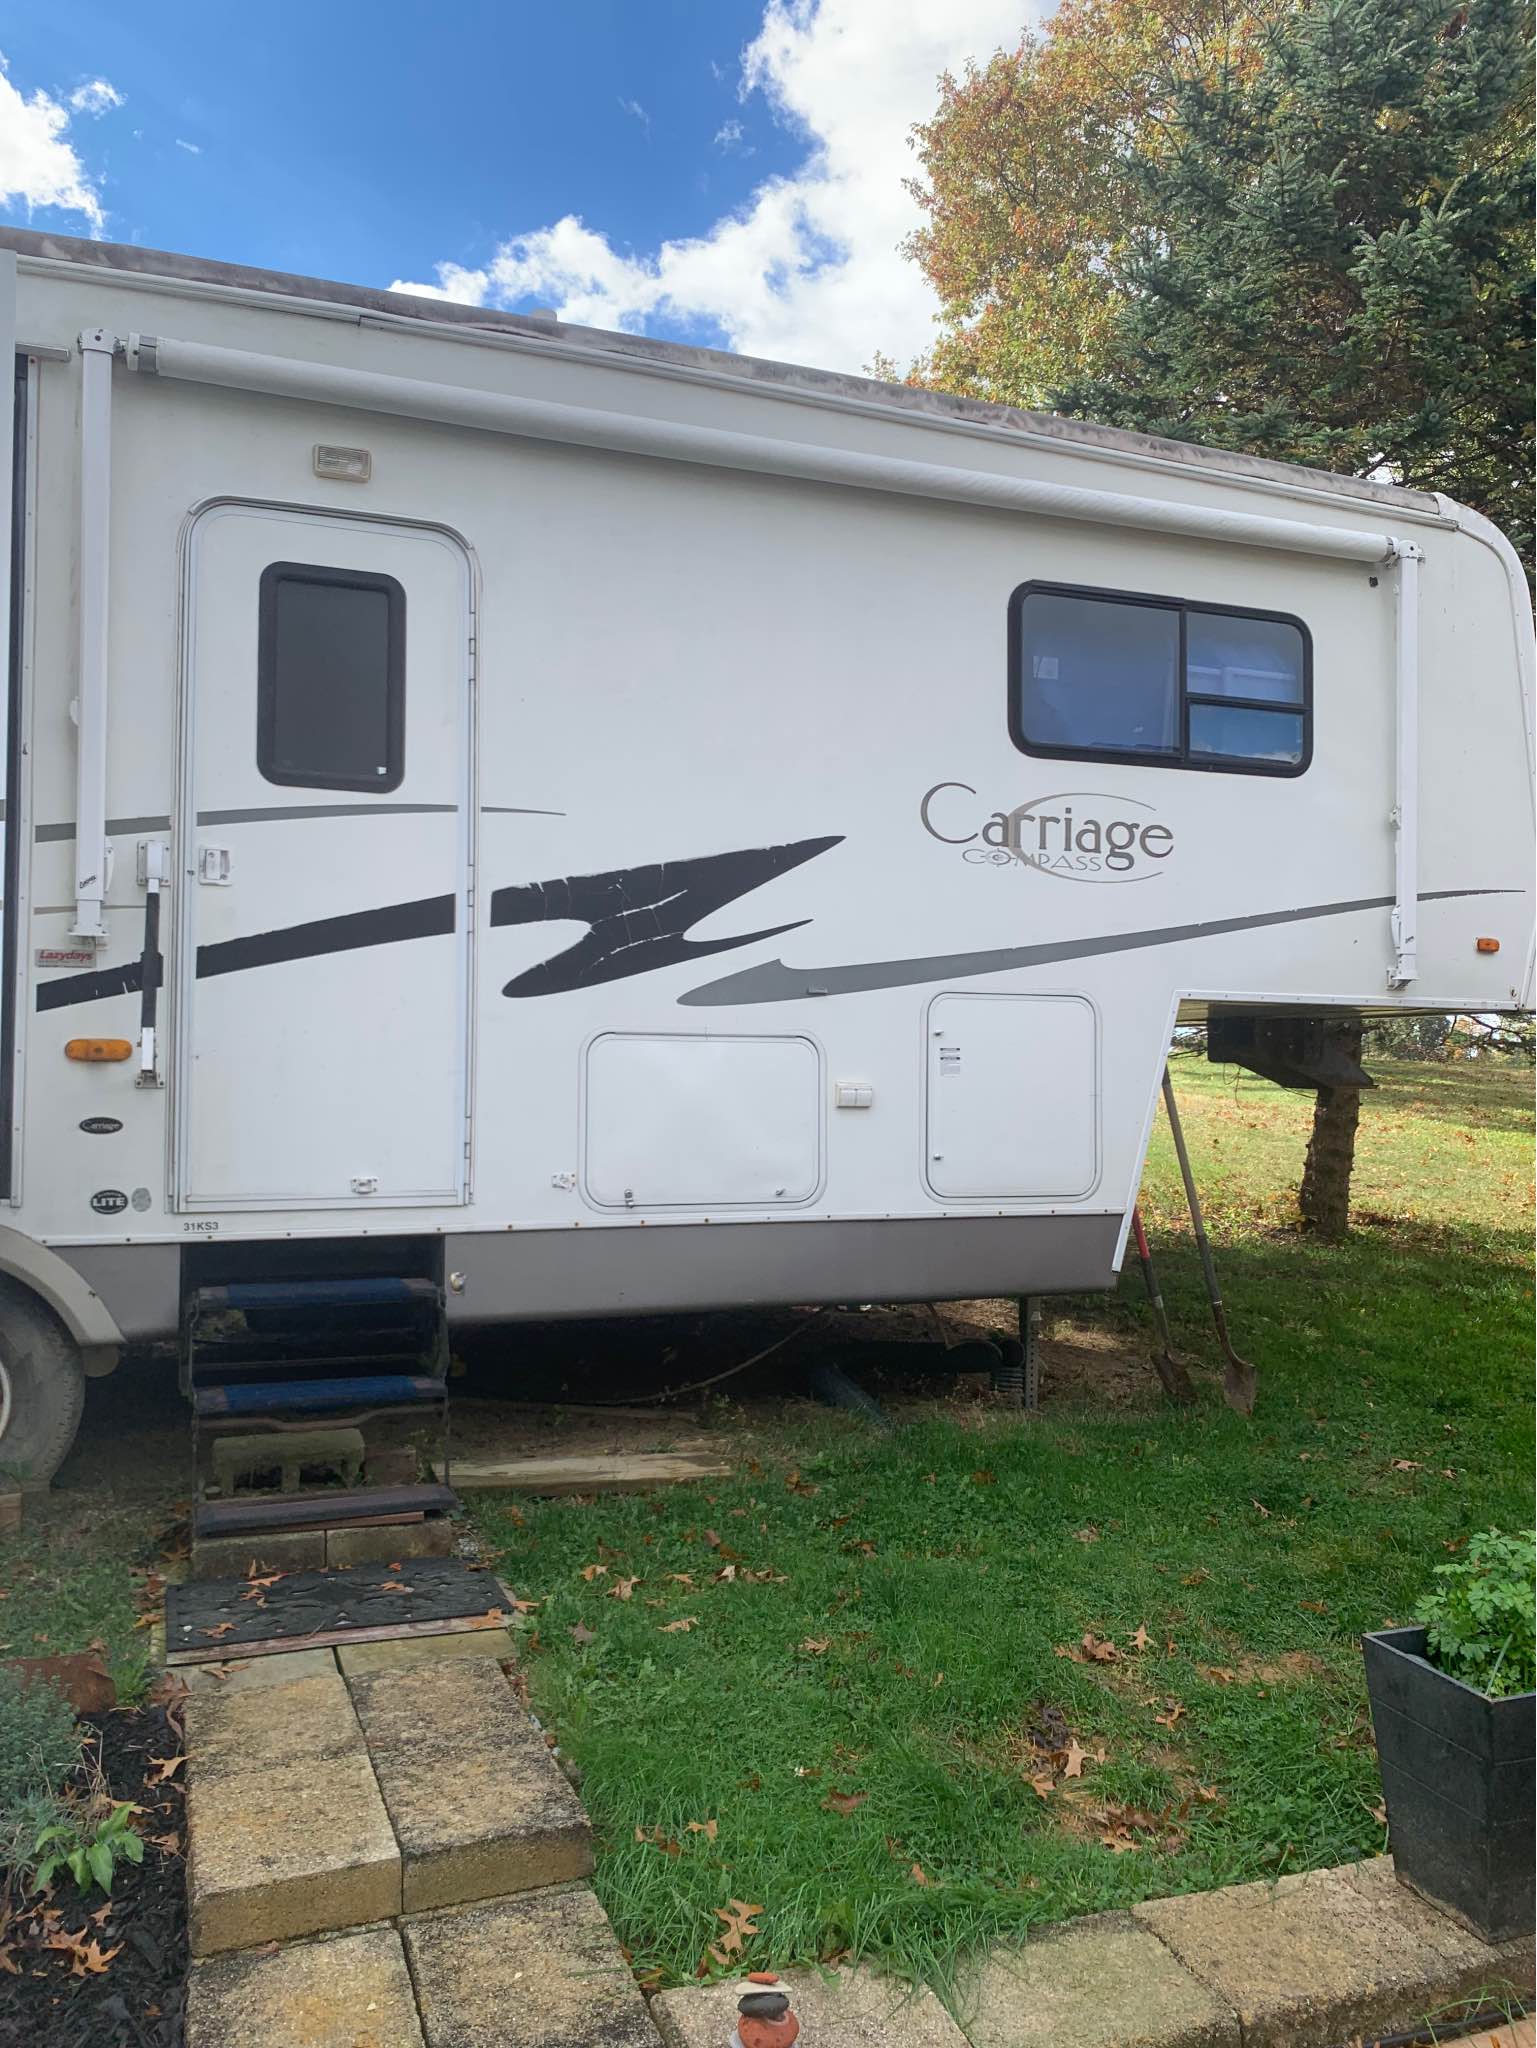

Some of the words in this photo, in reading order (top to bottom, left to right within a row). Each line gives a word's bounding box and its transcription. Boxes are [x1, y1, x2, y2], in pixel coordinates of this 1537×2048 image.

[920, 782, 1174, 871] Carriage
[962, 848, 1102, 872] COMPASS
[39, 950, 94, 962] Lazydays
[92, 1197, 126, 1207] LITE
[183, 1221, 219, 1232] 31KS3
